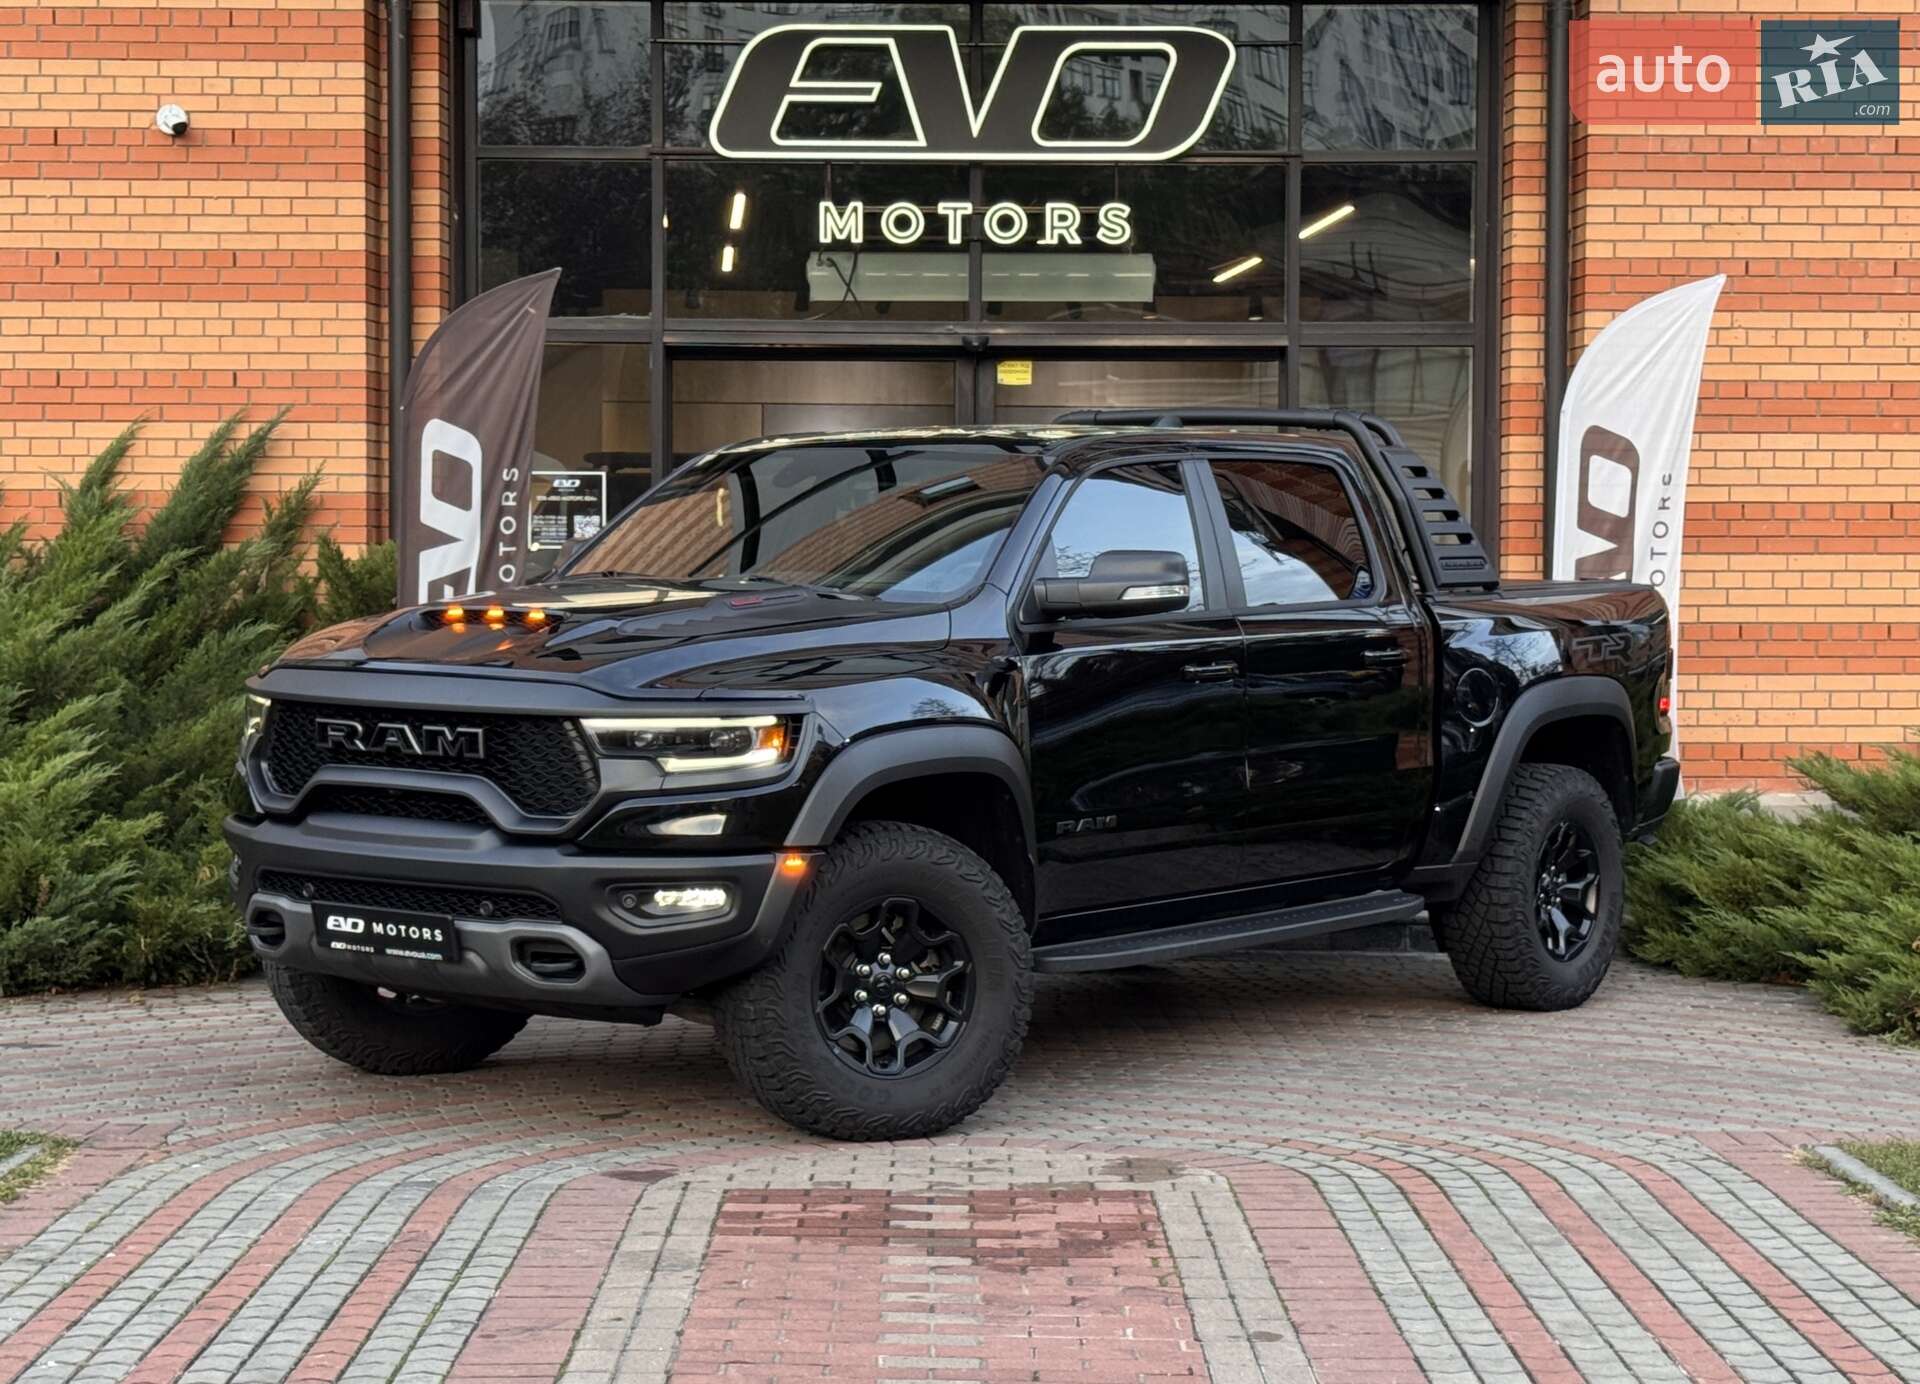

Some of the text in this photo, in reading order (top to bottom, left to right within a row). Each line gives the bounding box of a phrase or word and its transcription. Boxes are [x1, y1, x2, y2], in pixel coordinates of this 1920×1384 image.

[709, 23, 1237, 161] EVO
[818, 200, 1132, 246] MOTORS
[498, 467, 519, 583] OTORS
[1575, 425, 1640, 583] VO
[1650, 473, 1672, 588] OTORS
[315, 718, 485, 760] RAM
[326, 915, 444, 942] EVO MOTORS
